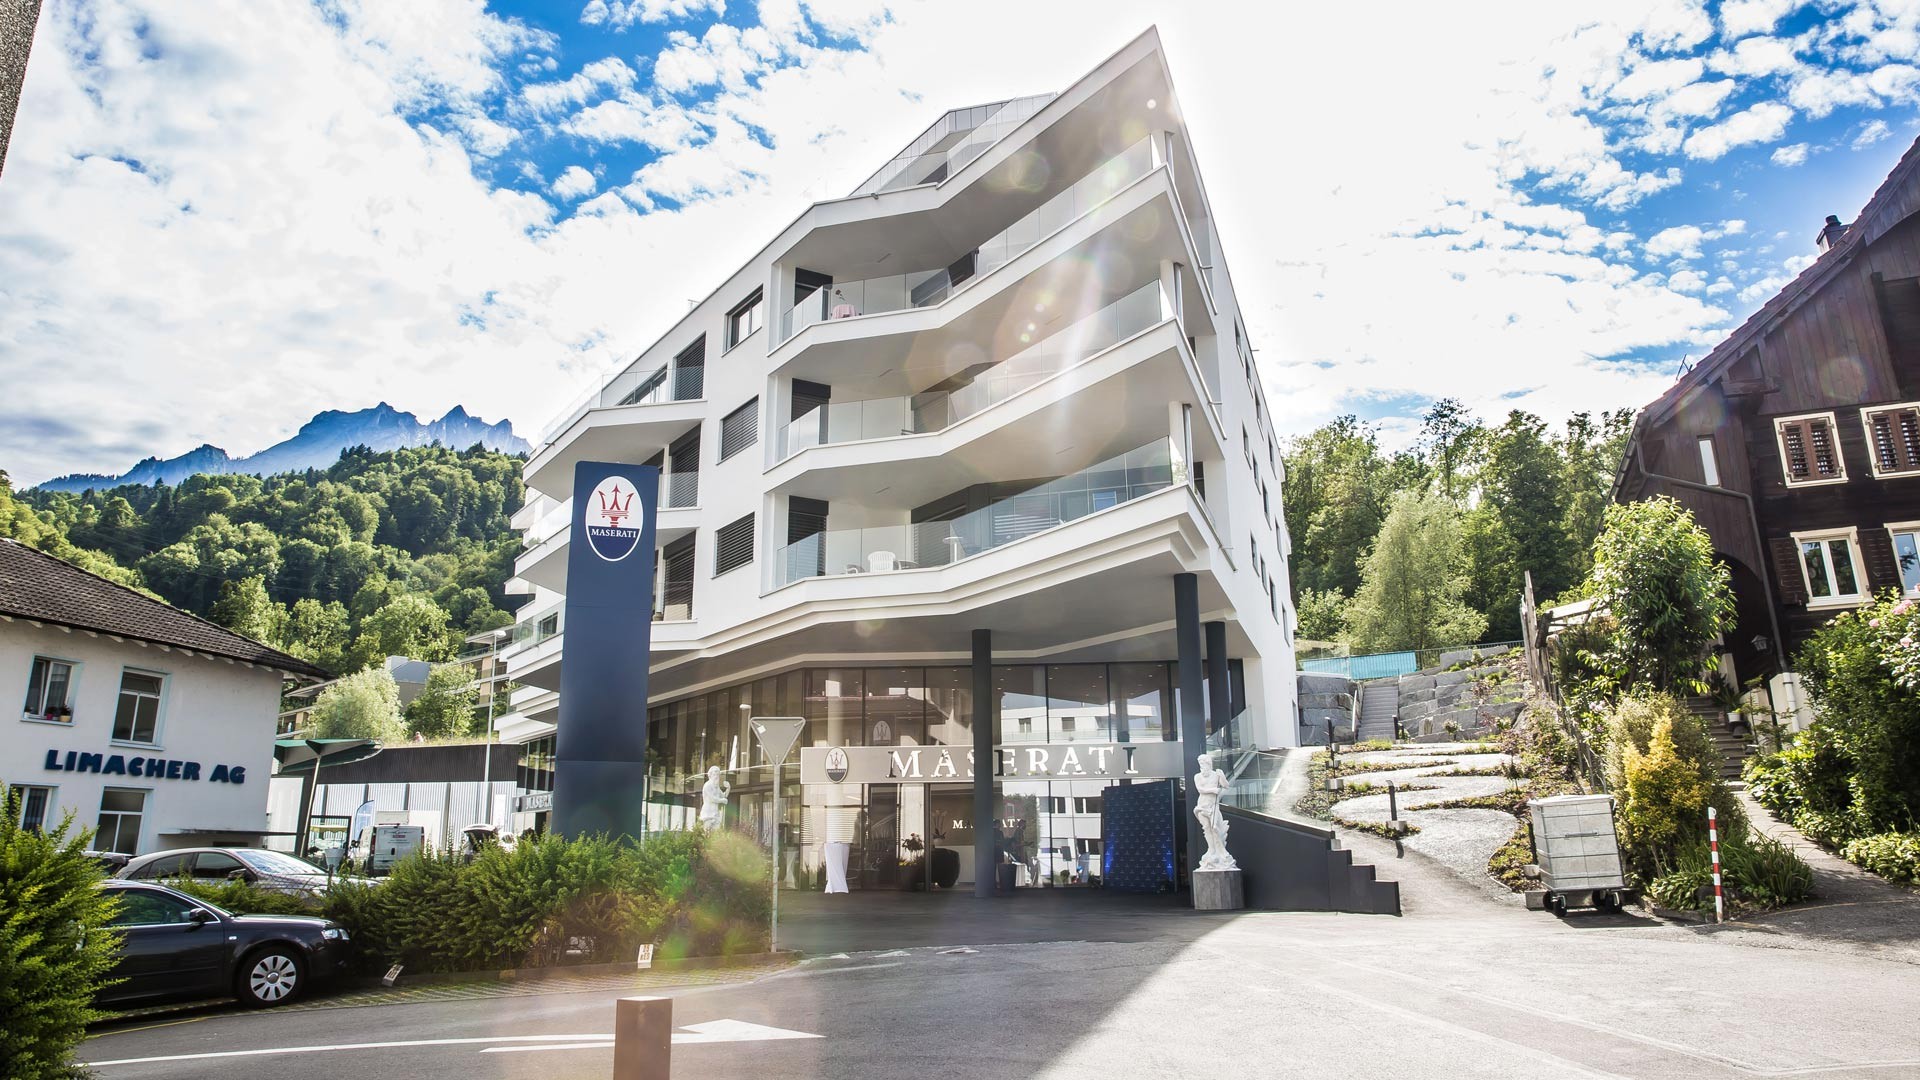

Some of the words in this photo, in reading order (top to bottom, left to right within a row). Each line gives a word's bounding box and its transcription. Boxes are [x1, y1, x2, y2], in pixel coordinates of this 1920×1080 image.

[591, 528, 637, 538] MASERATI
[44, 749, 201, 781] LIMACHER
[209, 764, 246, 784] AG
